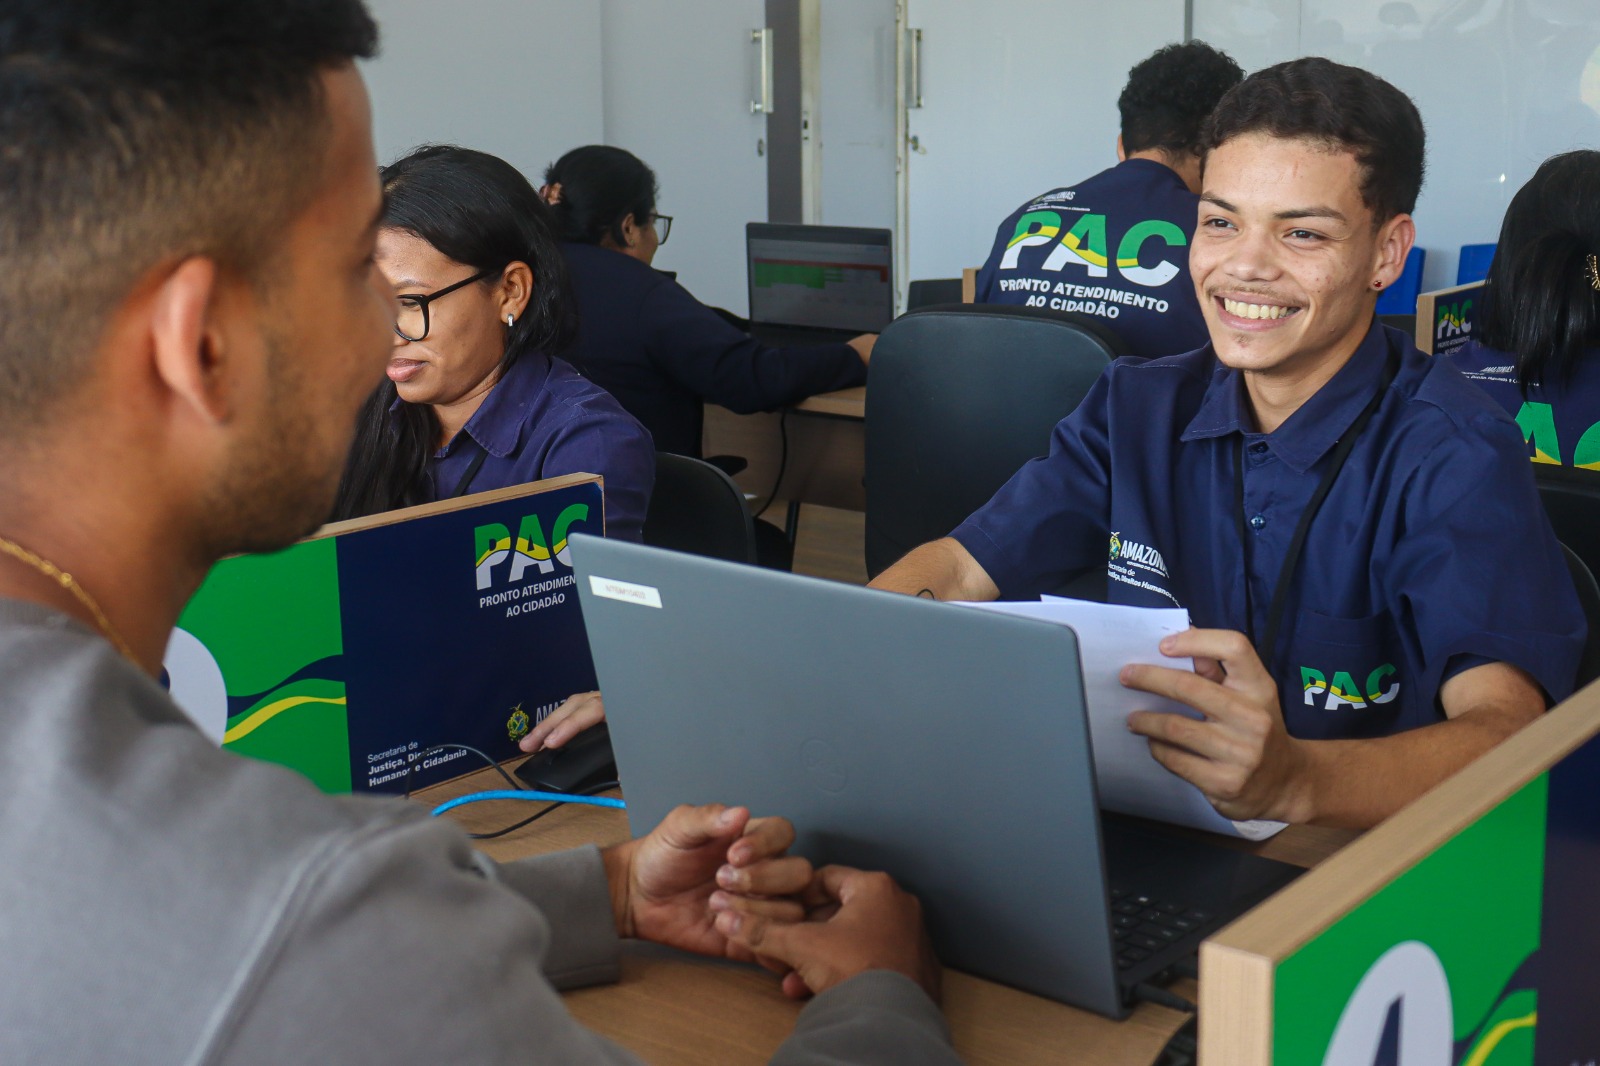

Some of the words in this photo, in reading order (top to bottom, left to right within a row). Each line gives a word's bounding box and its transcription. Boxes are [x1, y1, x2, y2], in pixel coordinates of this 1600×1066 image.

[999, 210, 1187, 287] PAC
[999, 278, 1051, 293] PRONTO
[1053, 282, 1169, 314] ATENDIMENTO
[1026, 295, 1046, 308] AO
[1049, 297, 1120, 319] CIDADÃO
[1437, 299, 1473, 339] PAC
[474, 503, 589, 591] PAC
[1119, 540, 1170, 579] AMAZON
[479, 588, 520, 609] PRONTO
[521, 574, 577, 598] ATENDIMEN
[506, 604, 521, 618] AO
[522, 593, 566, 613] CIDADÃO
[1300, 662, 1400, 711] PAC
[367, 745, 407, 764] Secretaria
[408, 741, 419, 750] de
[368, 758, 406, 775] Justiça,
[414, 764, 421, 772] e
[422, 748, 468, 769] Cidadania
